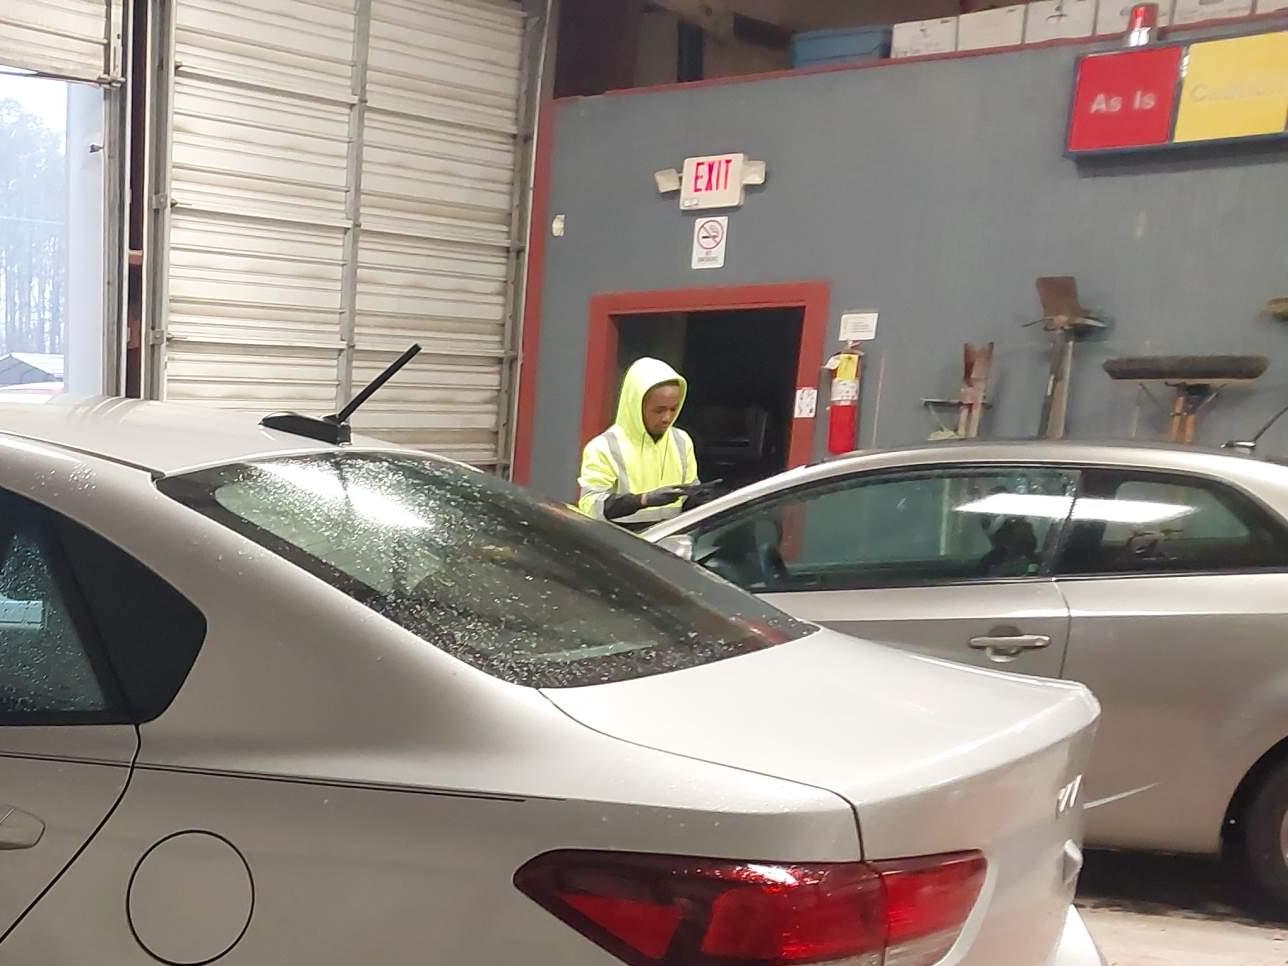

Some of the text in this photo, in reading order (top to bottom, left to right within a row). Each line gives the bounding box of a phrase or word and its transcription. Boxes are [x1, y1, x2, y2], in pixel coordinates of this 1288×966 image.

[1090, 89, 1157, 114] As Is
[693, 159, 733, 193] EXIT
